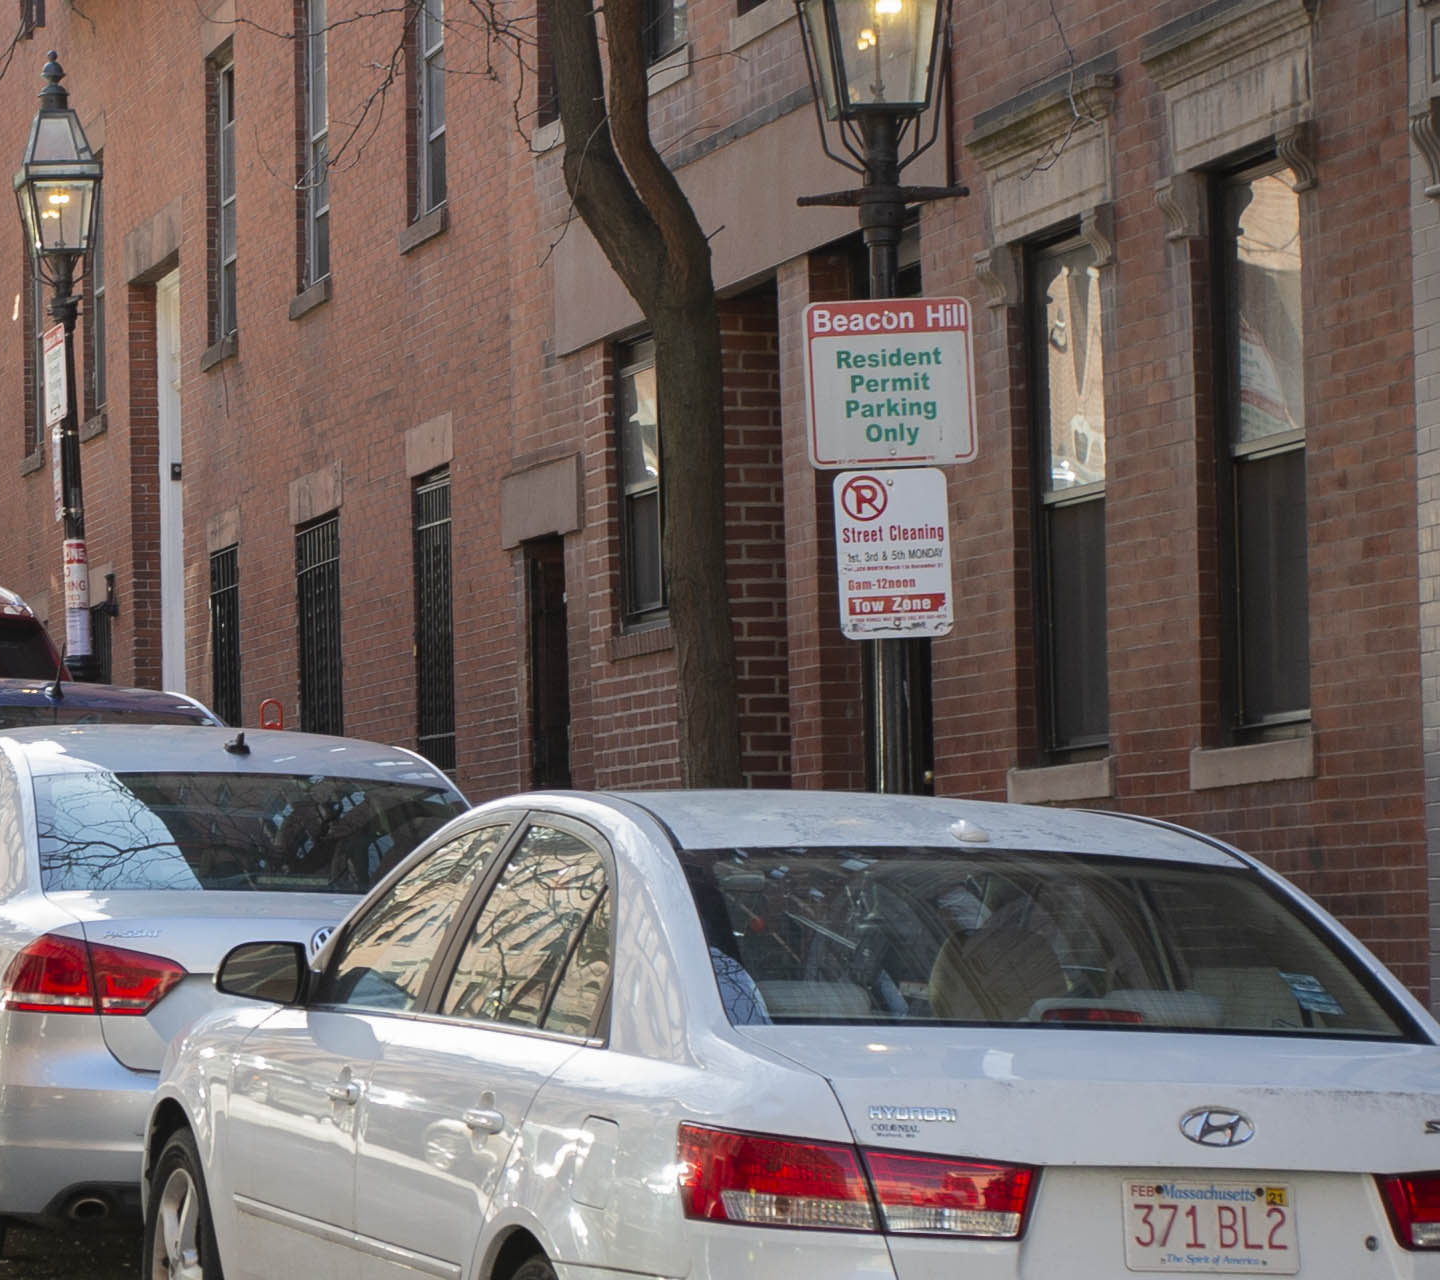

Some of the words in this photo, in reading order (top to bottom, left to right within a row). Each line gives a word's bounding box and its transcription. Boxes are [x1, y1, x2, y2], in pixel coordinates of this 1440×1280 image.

[813, 310, 914, 333] Beacon
[926, 304, 966, 328] Hill
[836, 347, 942, 369] Resident
[850, 372, 930, 393] Permit
[845, 398, 938, 420] Parking
[865, 423, 920, 446] Only
[843, 525, 884, 544] Street
[890, 524, 945, 542] Cleaning
[865, 552, 879, 562] 3rd
[882, 551, 888, 561] &
[892, 550, 905, 561] 5th
[908, 548, 944, 559] MONDAY
[852, 598, 885, 613] Tow
[891, 596, 932, 612] Zone
[868, 1105, 957, 1122] HYUNDAI
[871, 1123, 920, 1133] COLONIAL
[1130, 1184, 1154, 1197] FEB
[1161, 1184, 1257, 1202] Massachusetts
[1269, 1191, 1284, 1204] 21
[1134, 1204, 1206, 1248] 371
[1218, 1205, 1288, 1250] BL2
[1167, 1254, 1183, 1263] The
[1186, 1255, 1210, 1266] Spirit
[1212, 1255, 1220, 1264] of
[1223, 1256, 1260, 1265] America
